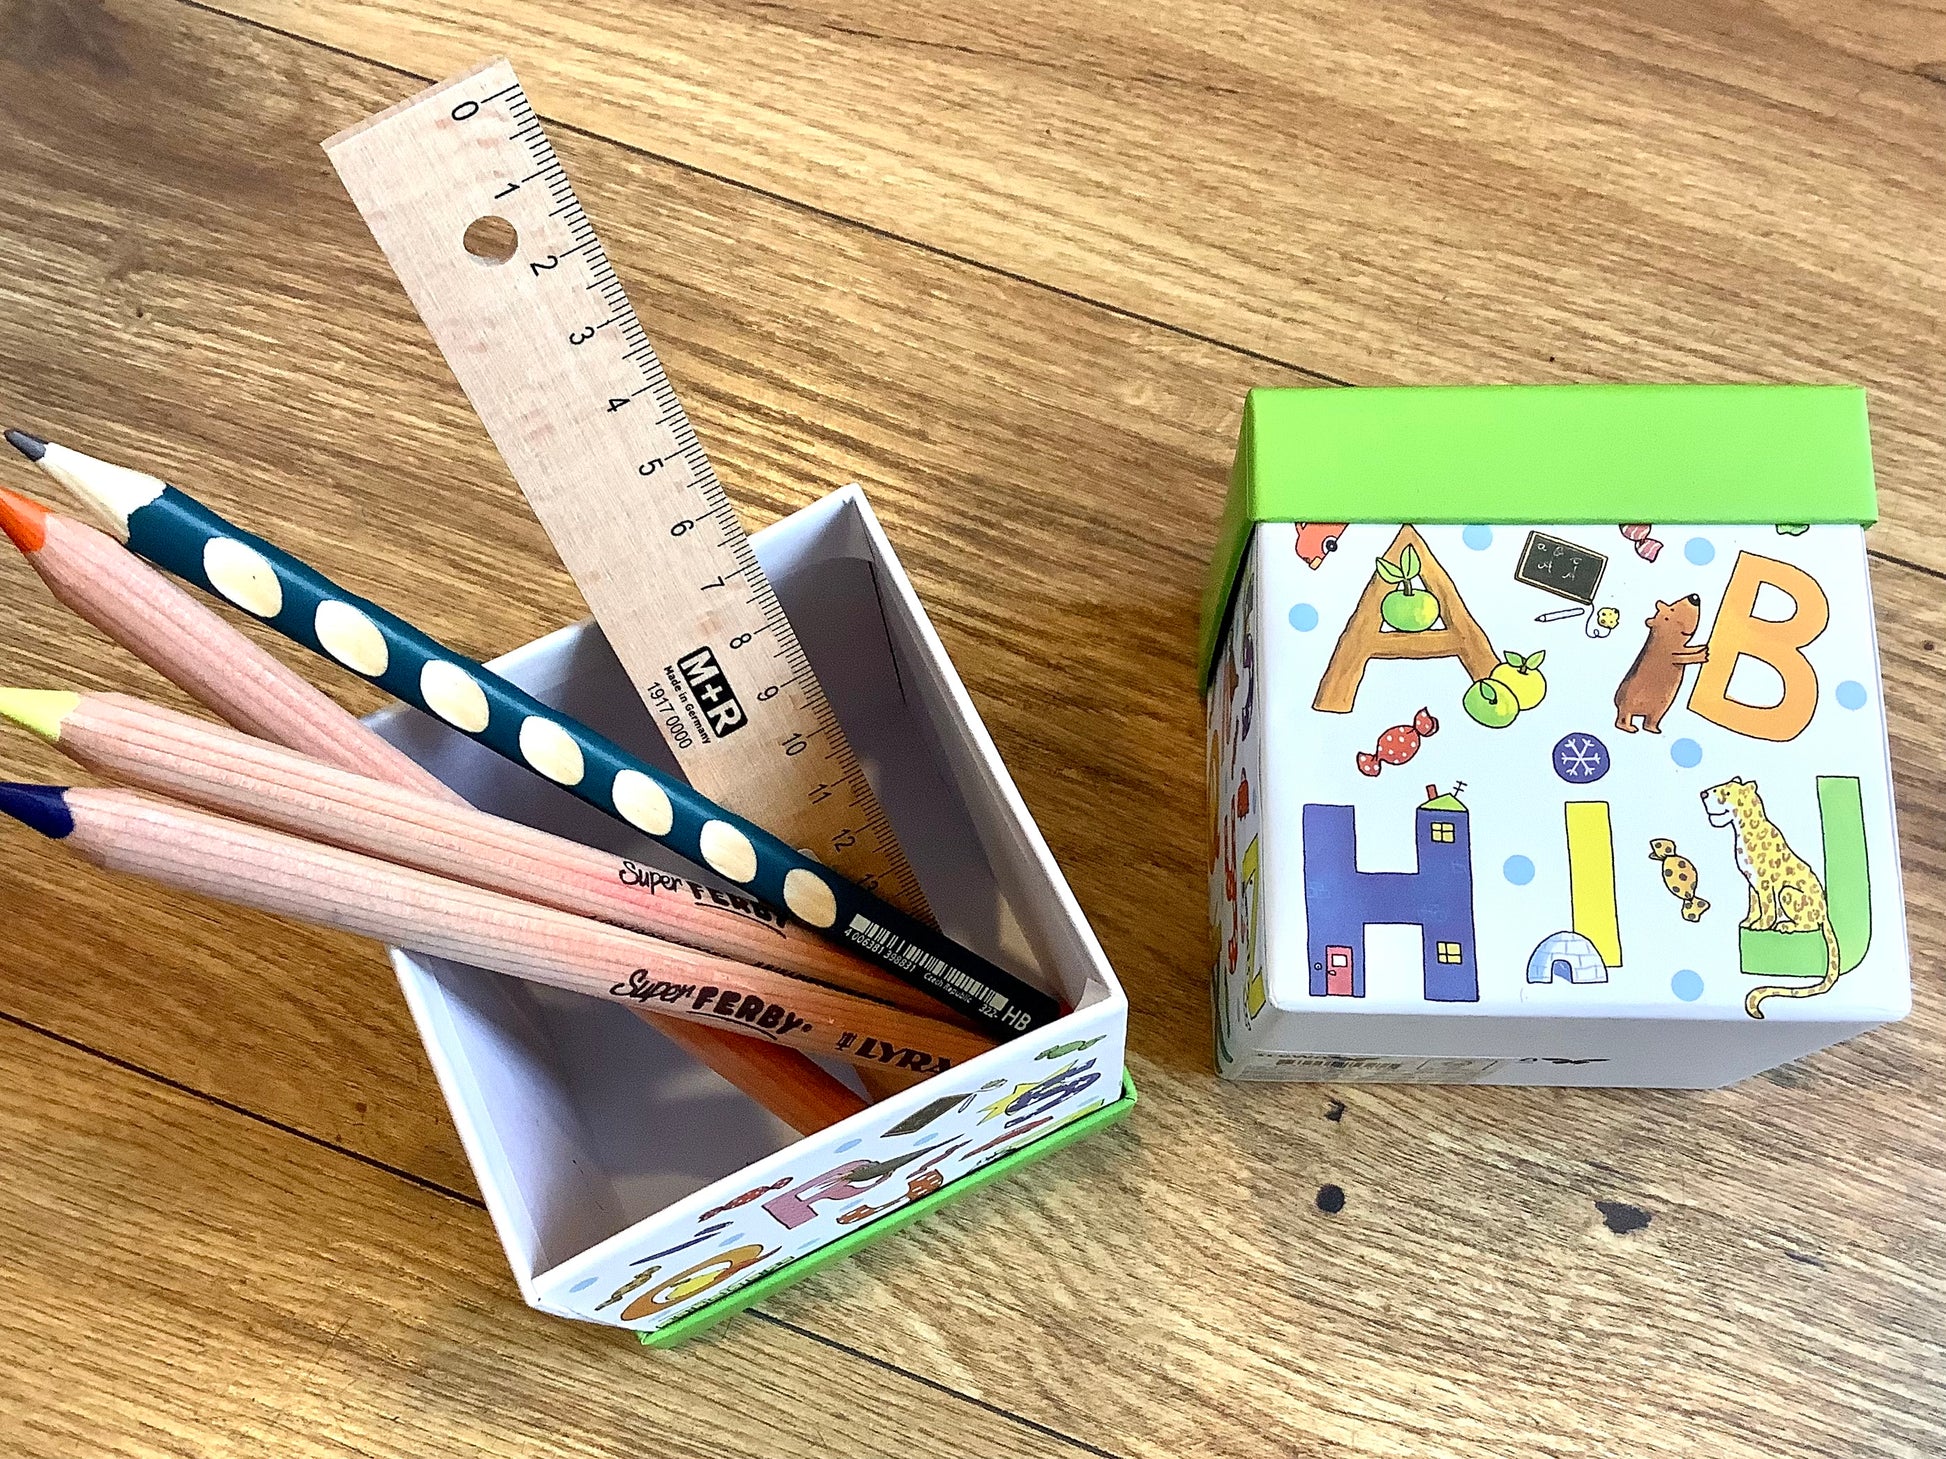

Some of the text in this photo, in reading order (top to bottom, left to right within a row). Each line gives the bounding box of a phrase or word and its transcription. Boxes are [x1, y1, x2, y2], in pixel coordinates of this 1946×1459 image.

[451, 100, 479, 121] 0
[494, 182, 520, 199] 1
[529, 254, 558, 277] 2
[569, 325, 595, 346] 3
[606, 397, 631, 413] 4
[638, 458, 664, 477] 5
[671, 519, 694, 537] 6
[700, 576, 725, 591] 7
[729, 632, 752, 649] 8
[1687, 550, 1829, 742] B
[664, 665, 711, 744] Made in Germany
[680, 650, 742, 736] M+R
[757, 685, 779, 702] 9
[647, 681, 693, 749] 1917 0000
[782, 733, 807, 756] 10
[808, 783, 832, 805] 11
[832, 828, 856, 853] 12
[619, 861, 683, 895] Super
[1740, 776, 1872, 977] J
[1303, 802, 1480, 1002] H
[844, 928, 917, 973] 4 006381 398831
[610, 969, 696, 1004] Super
[924, 972, 973, 1004] Czech Republic
[1001, 1006, 1031, 1031] HB
[855, 1037, 952, 1073] LYRA
